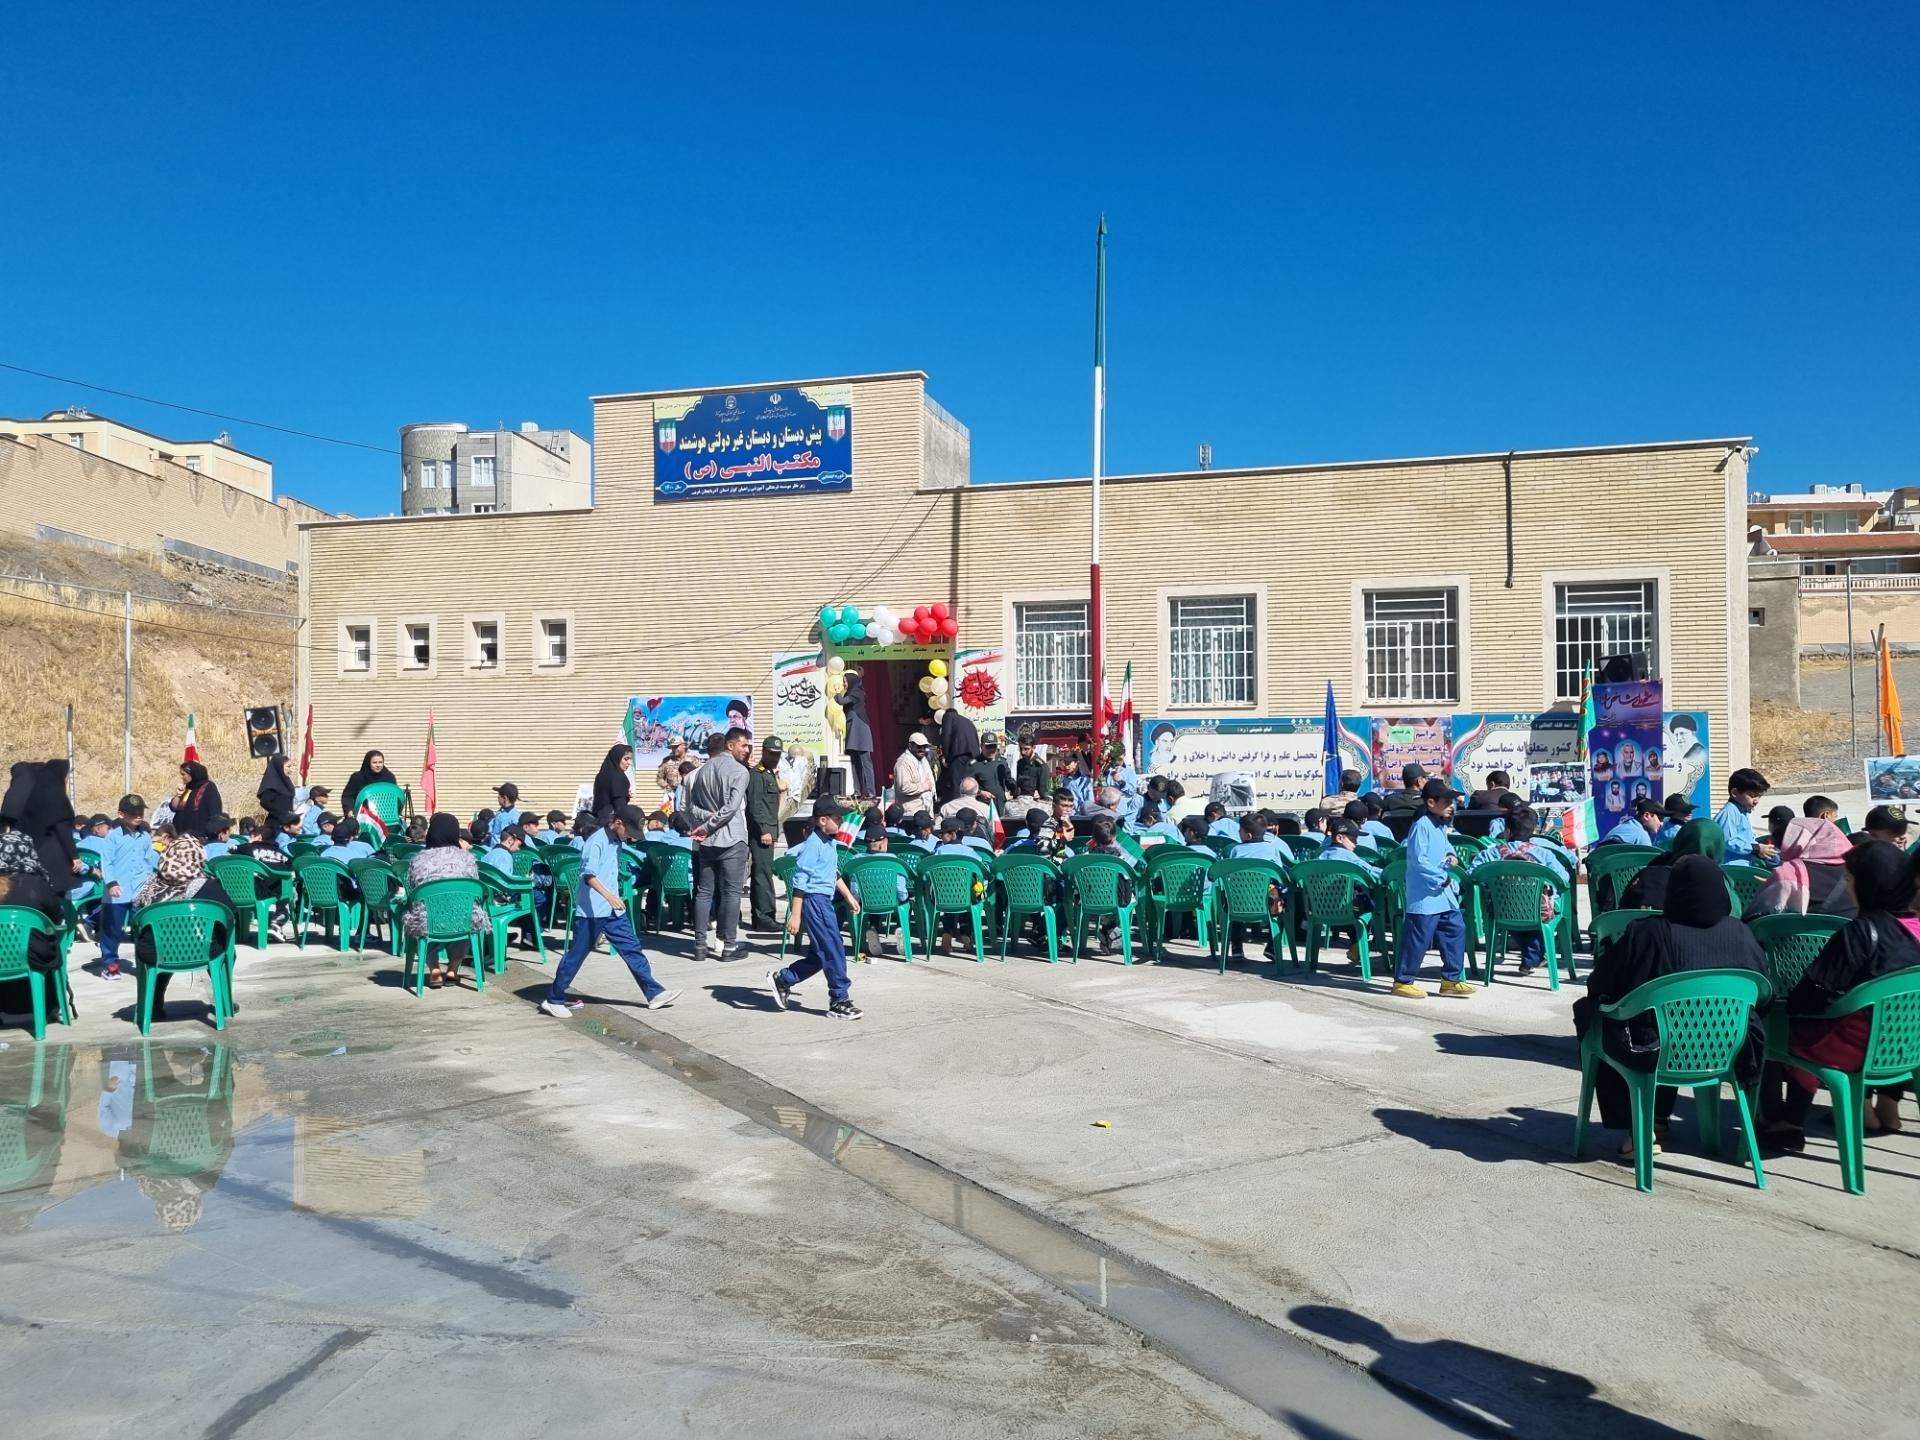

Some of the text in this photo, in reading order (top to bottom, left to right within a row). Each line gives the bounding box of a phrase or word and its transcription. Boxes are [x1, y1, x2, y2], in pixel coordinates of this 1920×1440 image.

[679, 424, 822, 454] پیش دبستان و دبستان غیر دولتی هوشمند
[720, 453, 772, 479] النبی
[773, 451, 821, 475] مکتب
[1415, 730, 1437, 739] مراسم
[1383, 744, 1441, 754] مدرسه غیر دولتی
[1486, 742, 1514, 753] شماست
[1516, 743, 1524, 753] به
[1526, 741, 1548, 756] متعلق
[1550, 742, 1572, 756] کشور
[1189, 751, 1209, 762] اخلاق
[1211, 754, 1215, 762] و
[1217, 751, 1236, 762] دانش
[1273, 754, 1277, 762] و
[1279, 751, 1290, 762] علم
[1292, 751, 1317, 762] تحصیل
[1470, 761, 1483, 772] بود
[1485, 761, 1514, 772] خواهید
[1165, 769, 1179, 781] برای
[1263, 770, 1271, 779] که
[1271, 792, 1275, 800] و
[1277, 789, 1294, 800] بزرگ
[1297, 789, 1315, 800] اسلام
